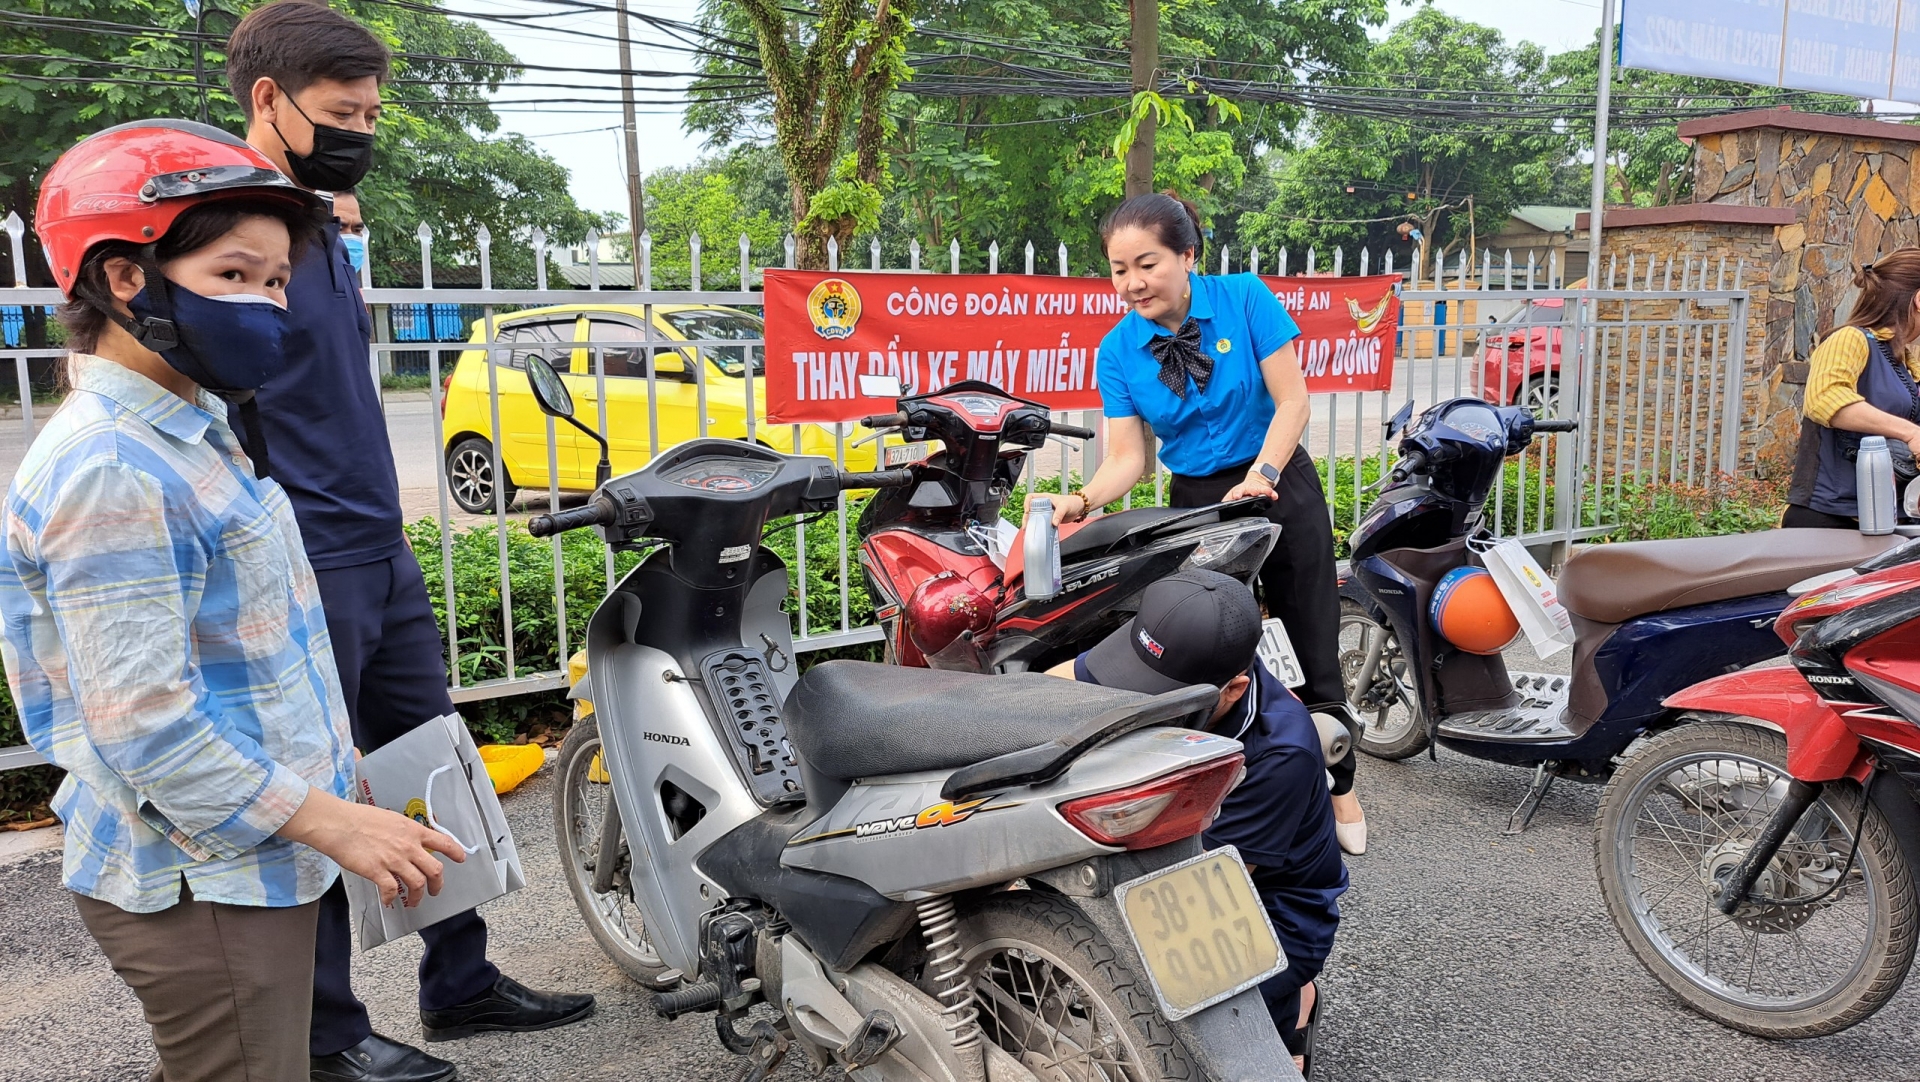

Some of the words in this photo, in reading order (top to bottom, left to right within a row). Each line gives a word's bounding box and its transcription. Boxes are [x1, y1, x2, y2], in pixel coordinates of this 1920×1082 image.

[887, 286, 958, 316] CÔNG
[965, 286, 1028, 316] ĐOÀN
[1035, 292, 1077, 316] KHU
[1275, 286, 1305, 316] GHỆ
[1308, 291, 1330, 311] AN
[792, 351, 860, 400] THAY
[927, 351, 959, 393] XE
[966, 340, 1021, 394] MÁY
[1025, 331, 1087, 393] MIỄN
[1297, 338, 1330, 378] LAO
[1065, 565, 1120, 592] BLADE
[1807, 675, 1854, 685] HONDA
[643, 731, 691, 746] HONDA
[856, 815, 916, 838] wave
[1140, 861, 1240, 941] 38-X1
